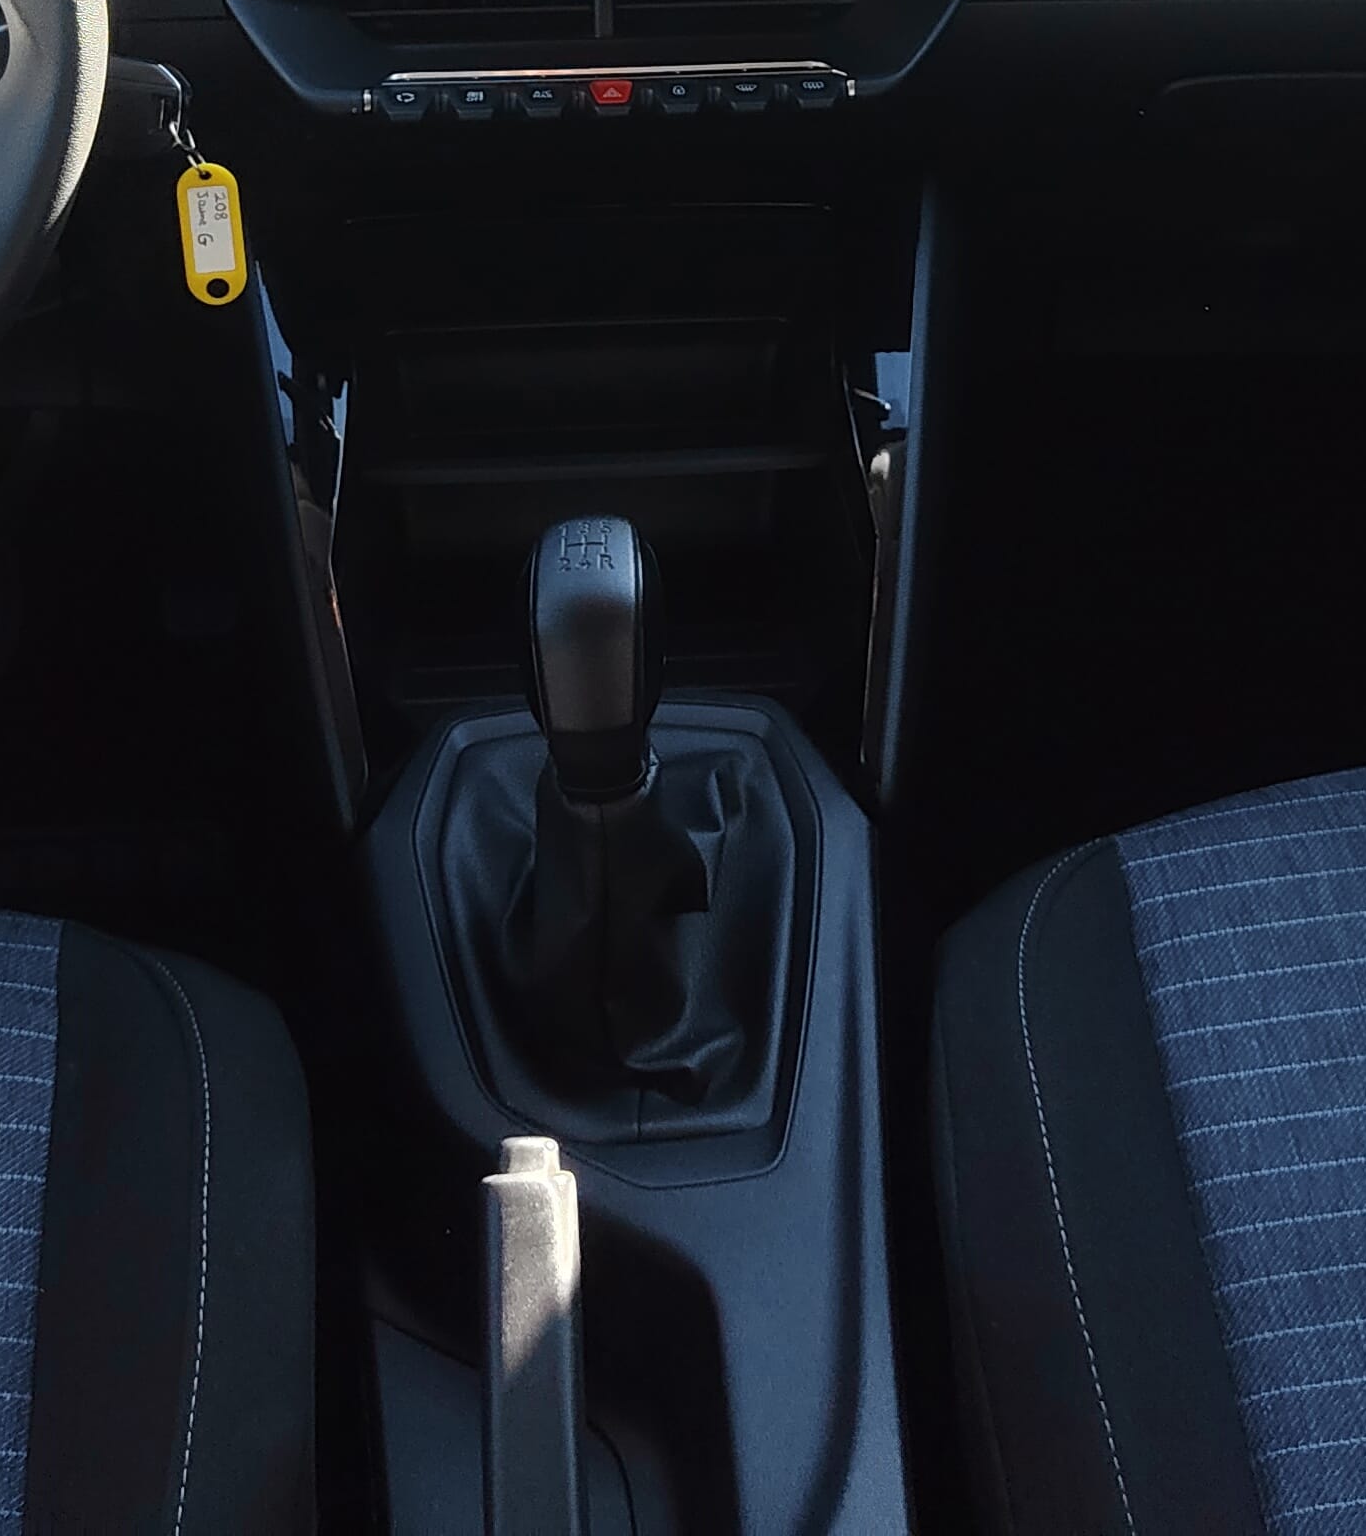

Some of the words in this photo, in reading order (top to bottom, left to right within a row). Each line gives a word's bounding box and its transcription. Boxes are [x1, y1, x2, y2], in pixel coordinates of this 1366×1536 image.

[213, 191, 228, 221] 208
[197, 233, 214, 247] G
[578, 521, 591, 534] 3
[599, 520, 612, 534] 5
[558, 557, 572, 572] 2
[598, 553, 615, 570] R
